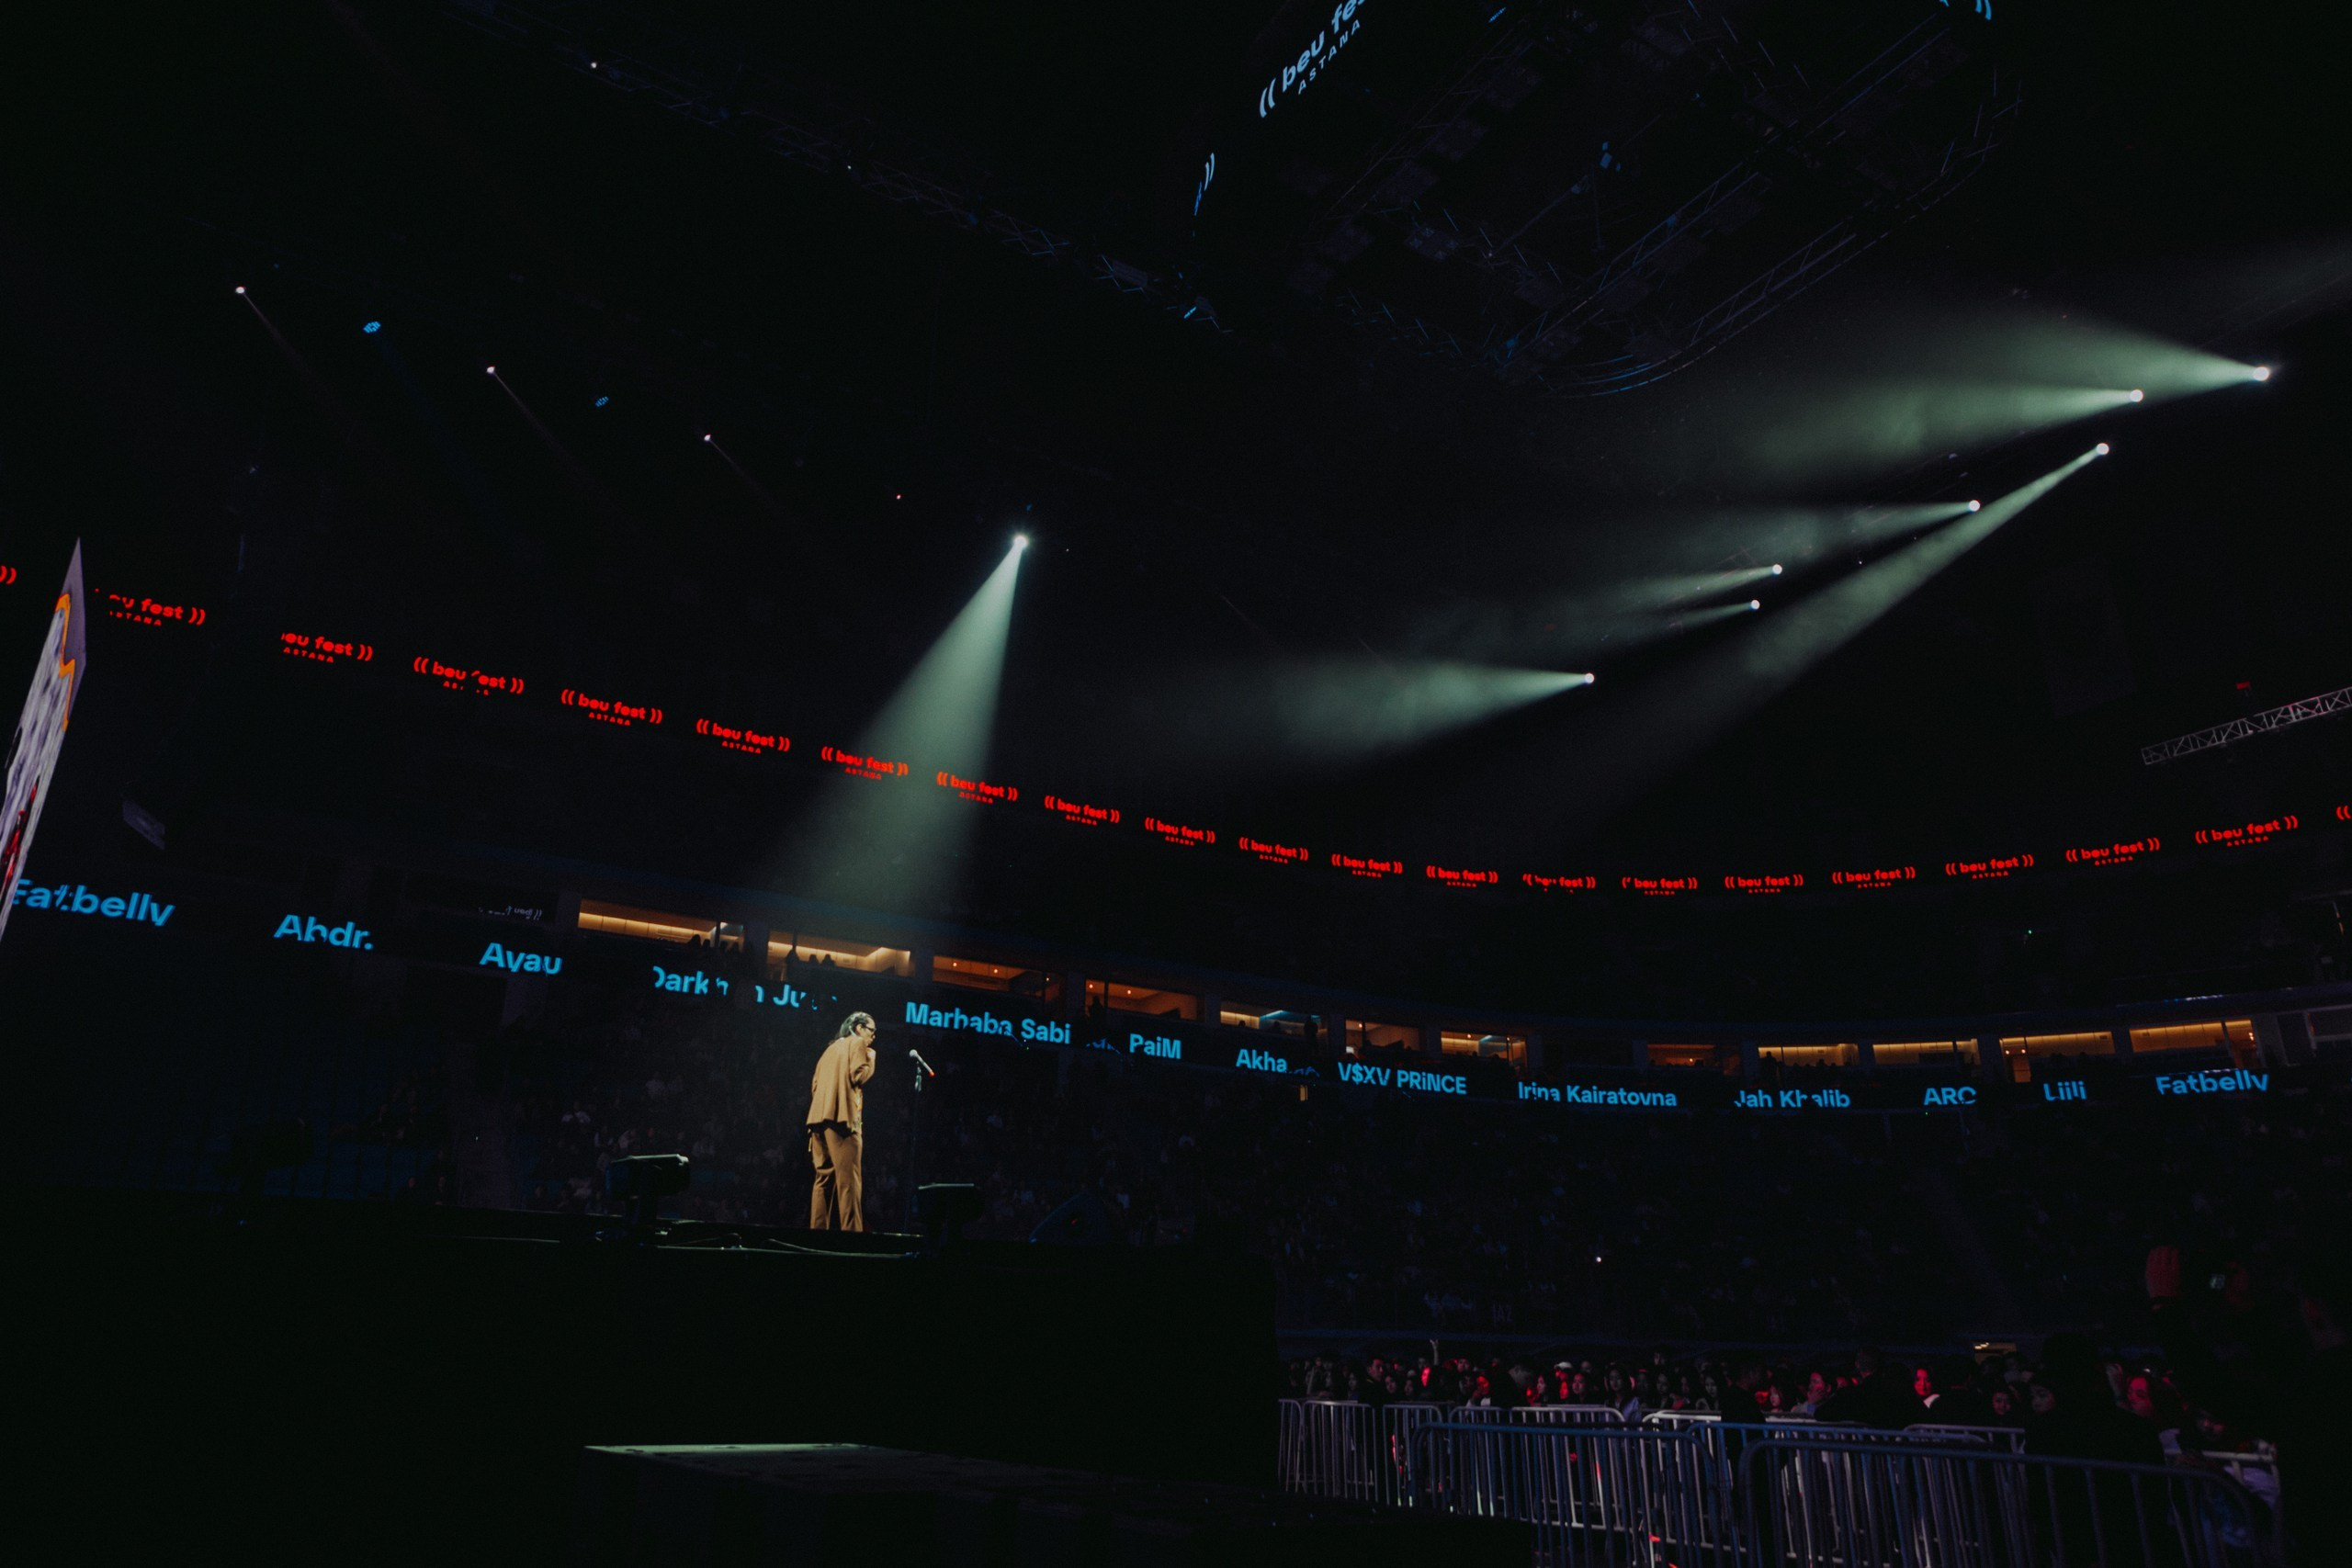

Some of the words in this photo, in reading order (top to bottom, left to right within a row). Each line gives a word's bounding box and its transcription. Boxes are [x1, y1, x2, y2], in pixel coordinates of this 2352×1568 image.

[1282, 30, 1325, 94] beu
[1297, 18, 1362, 96] ASTANA
[141, 598, 184, 620] fest
[283, 647, 334, 663] ASTANA
[315, 637, 353, 656] fest
[432, 661, 467, 681] beu
[578, 693, 609, 712] beu
[614, 702, 646, 720] fest
[712, 722, 741, 740] beu
[745, 730, 775, 748] fest
[835, 750, 864, 767] beu
[865, 757, 895, 774] fest
[950, 774, 976, 792] beu
[978, 782, 1005, 798] fest
[1057, 798, 1080, 814] beu
[1083, 804, 1108, 820] fest
[1156, 820, 1179, 835] beu
[1181, 826, 1204, 840] fest
[2211, 829, 2243, 841] beu
[2246, 819, 2280, 835] fest
[1250, 840, 1273, 854] beu
[1274, 843, 1297, 858] fest
[2081, 848, 2109, 860] beu
[2113, 841, 2144, 854] fest
[1343, 855, 1366, 869] beu
[1367, 859, 1391, 872] fest
[1960, 863, 1987, 874] beu
[1990, 857, 2018, 869] fest
[1559, 875, 1583, 888] fest
[1634, 877, 1657, 889] beu
[1659, 877, 1685, 889] fest
[1737, 876, 1762, 887] beu
[1765, 875, 1791, 886] fest
[1846, 872, 1871, 883] beu
[1874, 869, 1902, 880] fest
[905, 1000, 1014, 1037] Marhaba
[1021, 1018, 1071, 1044] Sabi
[1128, 1032, 1182, 1060] PaiM
[1337, 1061, 1392, 1087] V$XV
[1396, 1068, 1468, 1095] PRiNCE
[2154, 1068, 2269, 1096] Fatbelly
[1517, 1080, 1561, 1102] Irina
[1566, 1084, 1679, 1107] Kairatovna
